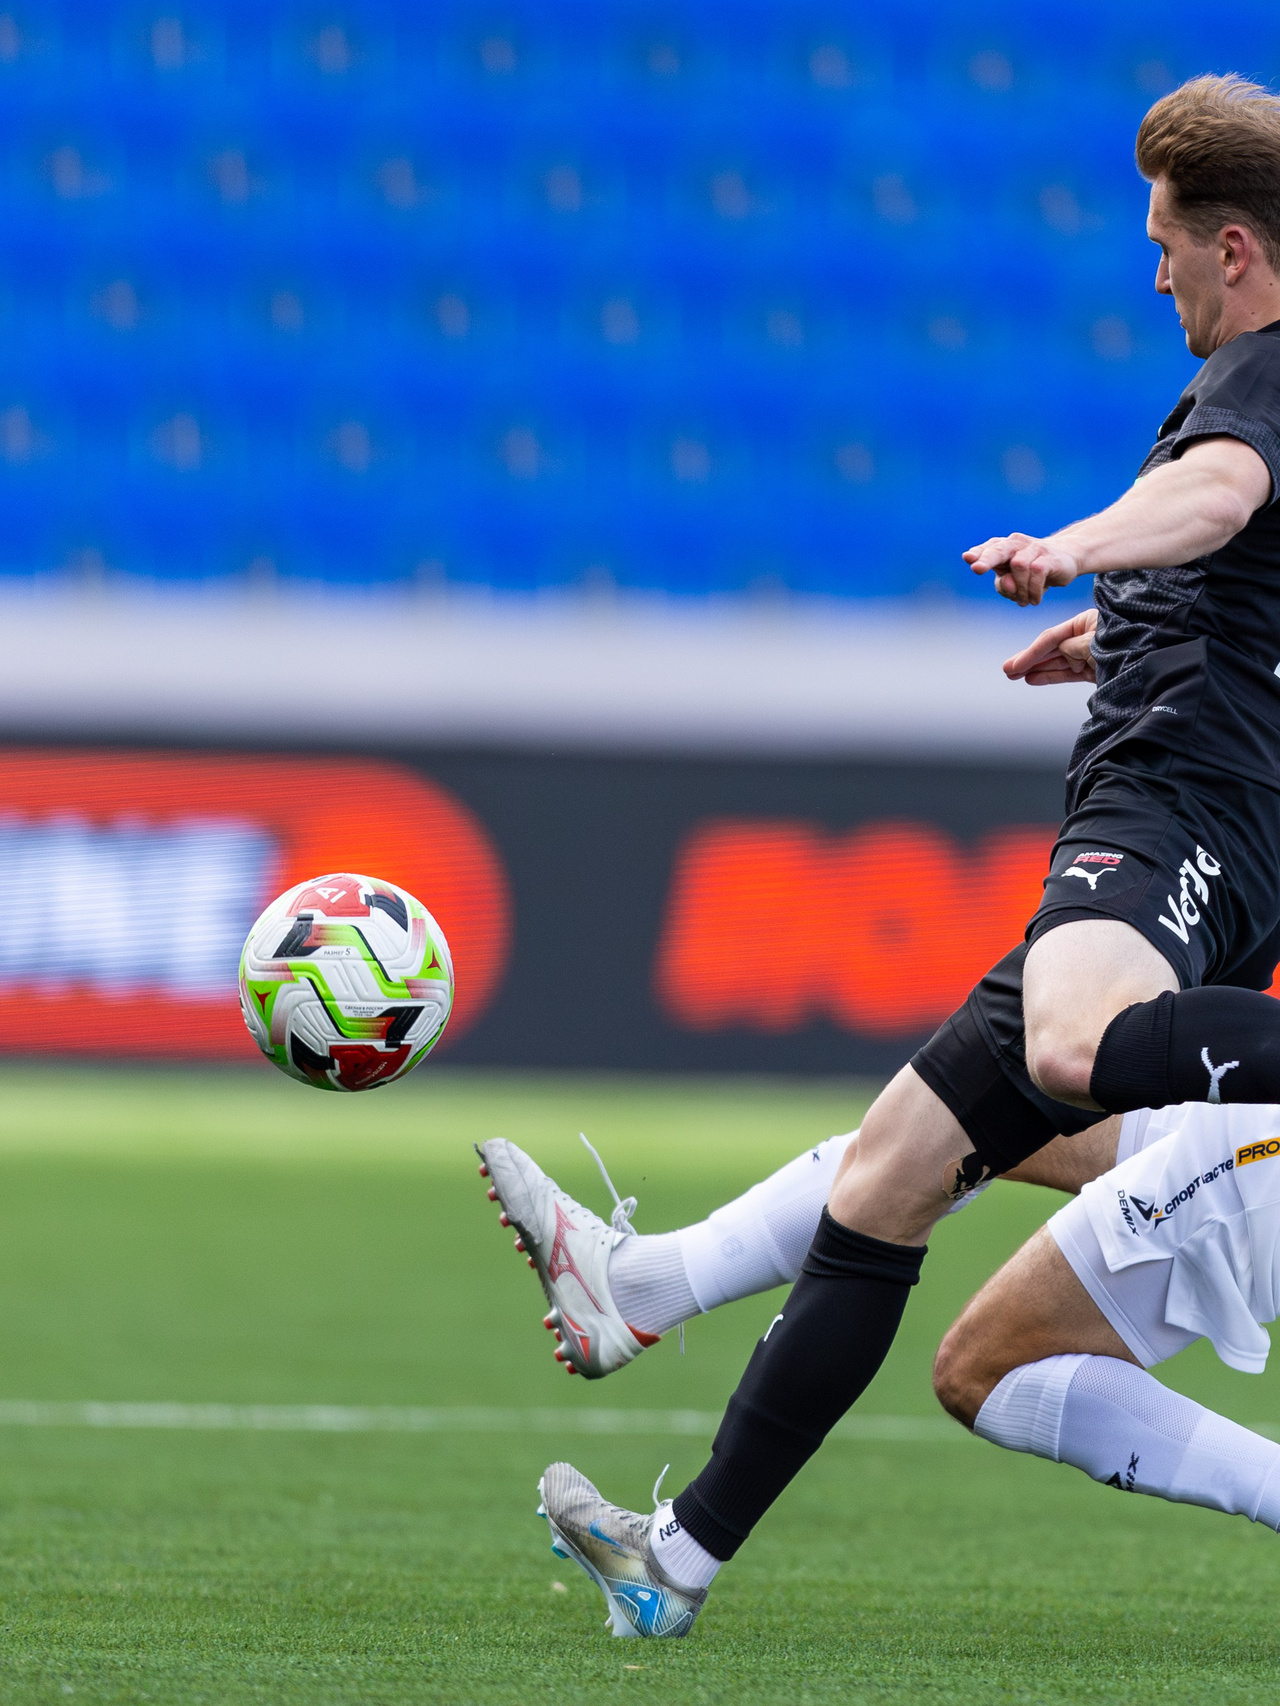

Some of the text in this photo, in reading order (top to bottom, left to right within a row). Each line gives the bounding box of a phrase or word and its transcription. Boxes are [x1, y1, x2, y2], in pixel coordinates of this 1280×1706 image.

[1151, 705, 1178, 715] DRYCELL
[1072, 855, 1121, 866] RED
[1077, 851, 1124, 860] AMAZING
[345, 947, 352, 956] 5
[1238, 1140, 1280, 1164] PRO
[1117, 1189, 1141, 1237] DEMIX
